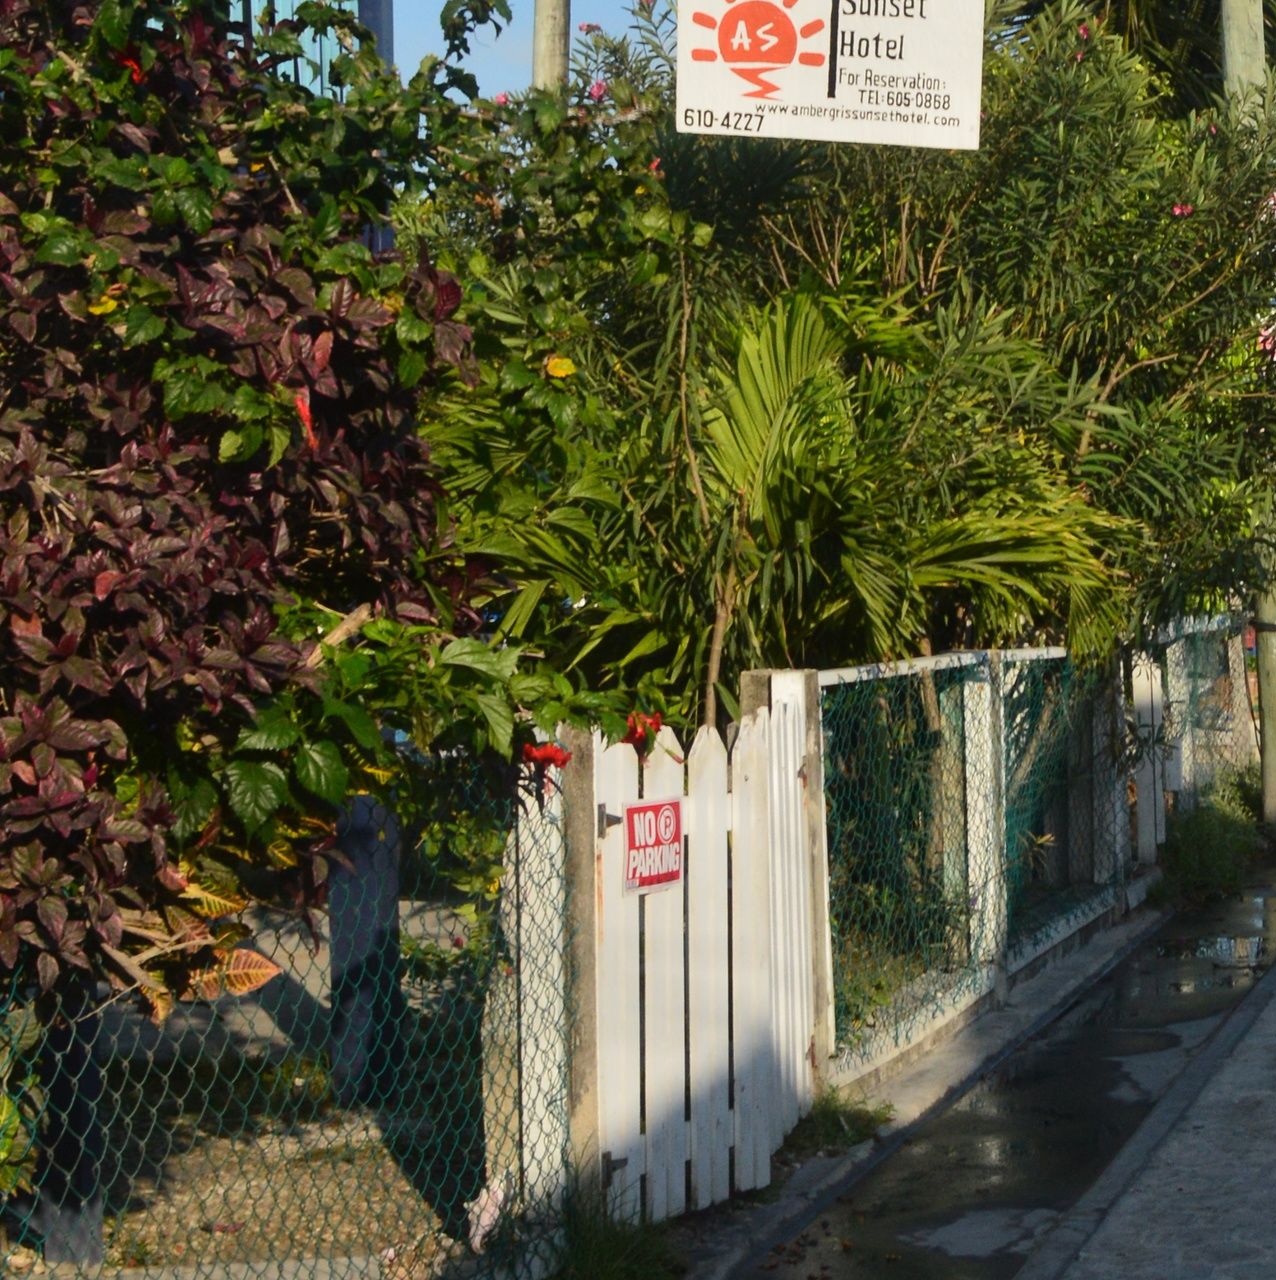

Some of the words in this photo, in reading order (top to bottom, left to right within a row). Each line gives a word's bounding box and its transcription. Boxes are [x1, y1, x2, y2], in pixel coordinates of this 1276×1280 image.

[840, 30, 904, 61] Hotel
[839, 67, 861, 86] For
[864, 68, 946, 91] Reservation:
[684, 108, 765, 132] 610-4227
[633, 810, 657, 847] NO
[627, 842, 680, 880] PARKING
